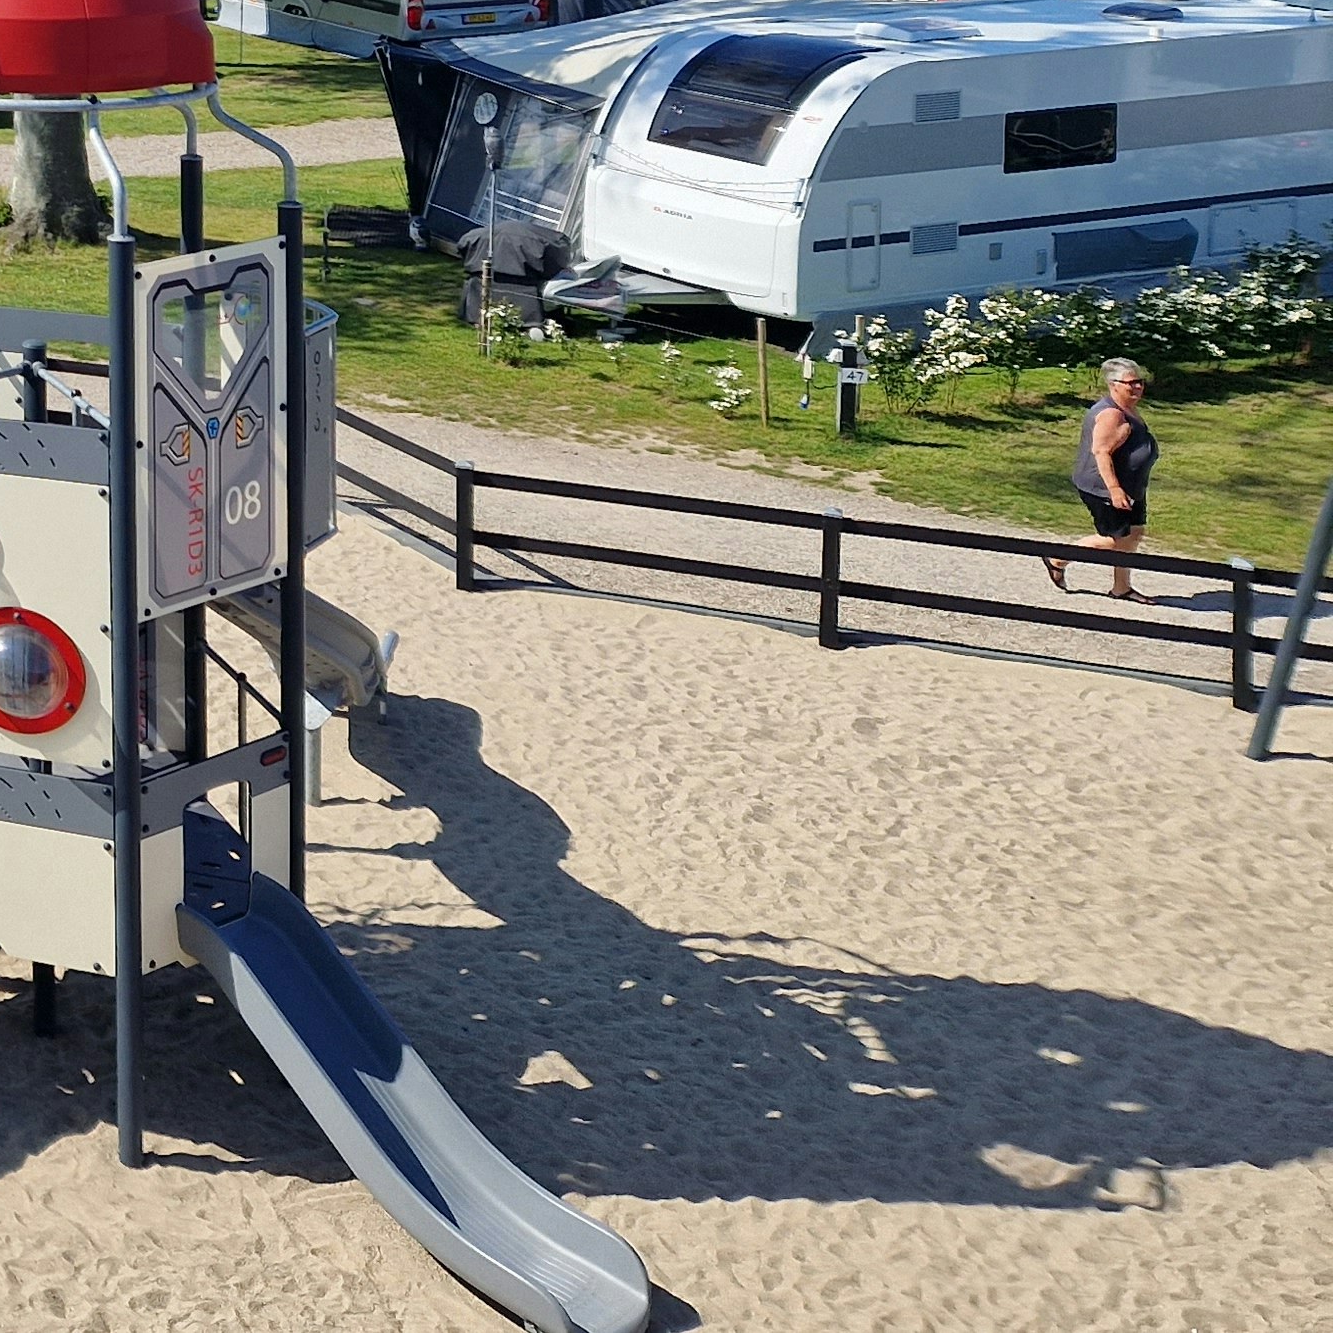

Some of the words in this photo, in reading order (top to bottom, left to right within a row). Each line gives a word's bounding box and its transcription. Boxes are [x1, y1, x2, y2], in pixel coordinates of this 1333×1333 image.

[846, 370, 864, 382] 47
[187, 466, 204, 576] SK-R1D3
[224, 480, 262, 525] 08
